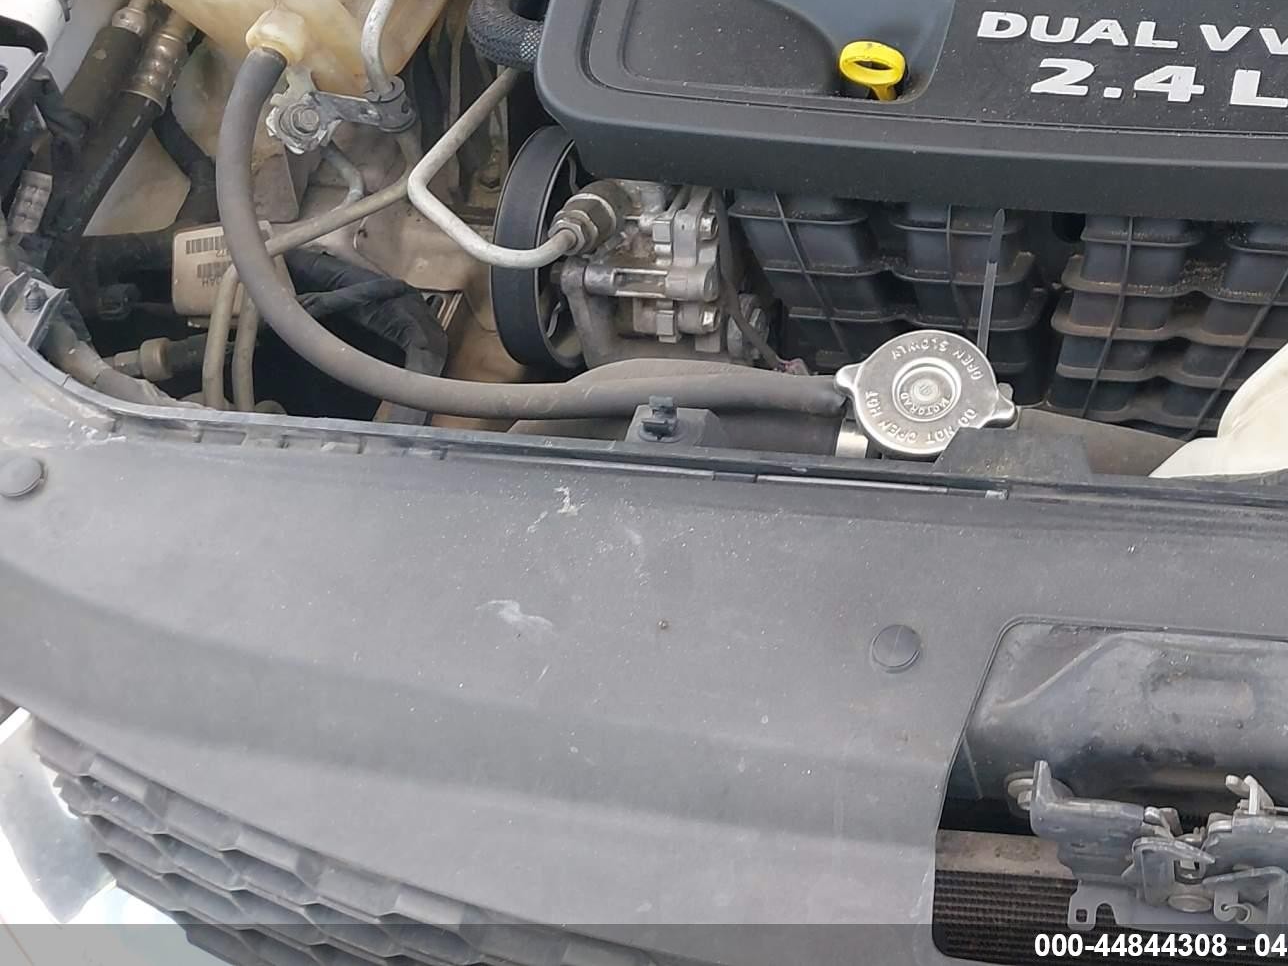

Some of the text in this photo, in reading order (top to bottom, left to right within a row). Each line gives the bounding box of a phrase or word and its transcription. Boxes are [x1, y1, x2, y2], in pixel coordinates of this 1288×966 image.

[977, 10, 1178, 49] DUAL
[1029, 58, 1288, 108] 2.4 L
[891, 338, 985, 382] OPEN SLOWLY
[865, 390, 978, 445] DO NOT OPEN HOT
[899, 391, 952, 418] MOTORAD
